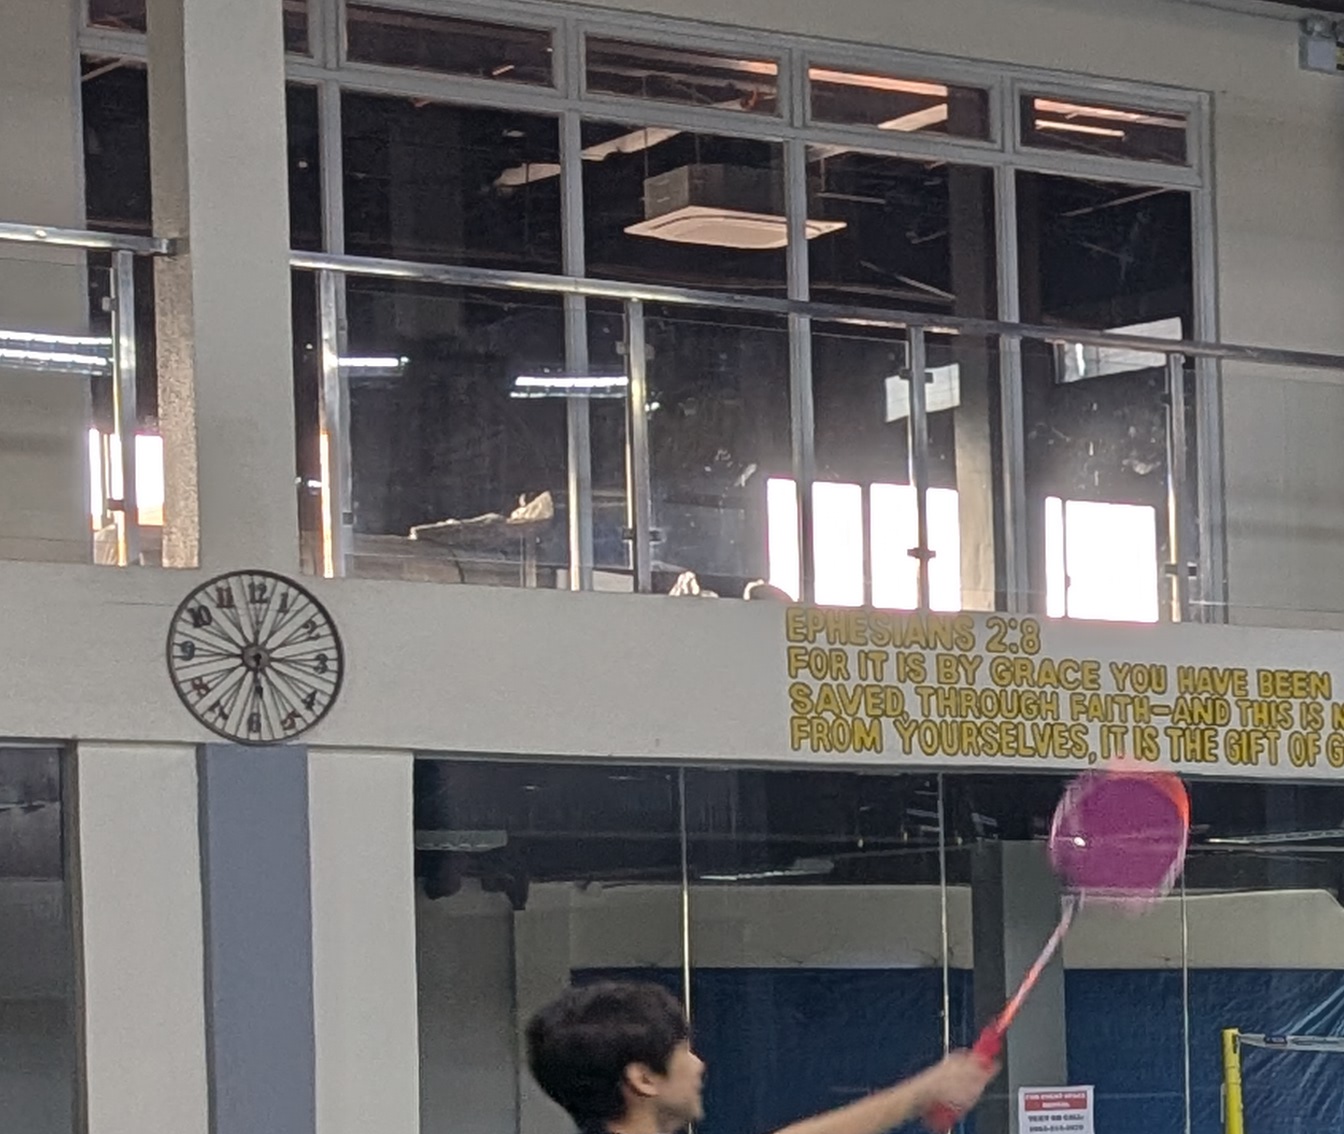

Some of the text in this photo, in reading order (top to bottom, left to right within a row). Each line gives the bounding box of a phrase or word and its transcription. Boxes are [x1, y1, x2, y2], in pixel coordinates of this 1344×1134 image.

[215, 586, 235, 608] 11
[248, 581, 269, 604] 12
[277, 592, 289, 613] 1
[187, 605, 212, 628] 10
[301, 619, 320, 641] 2
[786, 607, 1041, 655] EPHESIANS 2:8
[180, 640, 195, 661] 9
[313, 653, 329, 674] 3
[787, 646, 1332, 701] FOR IT IS BY GRACE YOU HAVE BEEN
[191, 676, 211, 697] 8
[208, 699, 229, 720] 7
[301, 690, 318, 710] 4
[789, 682, 910, 723] SAVED,
[915, 685, 1059, 721] THROUGH
[1236, 699, 1293, 731] THIS
[1299, 702, 1325, 732] IS
[282, 709, 302, 730] 5
[790, 716, 884, 753] FROM
[893, 719, 1096, 764] YOURSELVES,
[1099, 725, 1129, 759] IT
[1133, 726, 1160, 761] IS
[1166, 728, 1219, 763] THE
[1224, 729, 1281, 765] GIFT
[1287, 732, 1321, 767] OF
